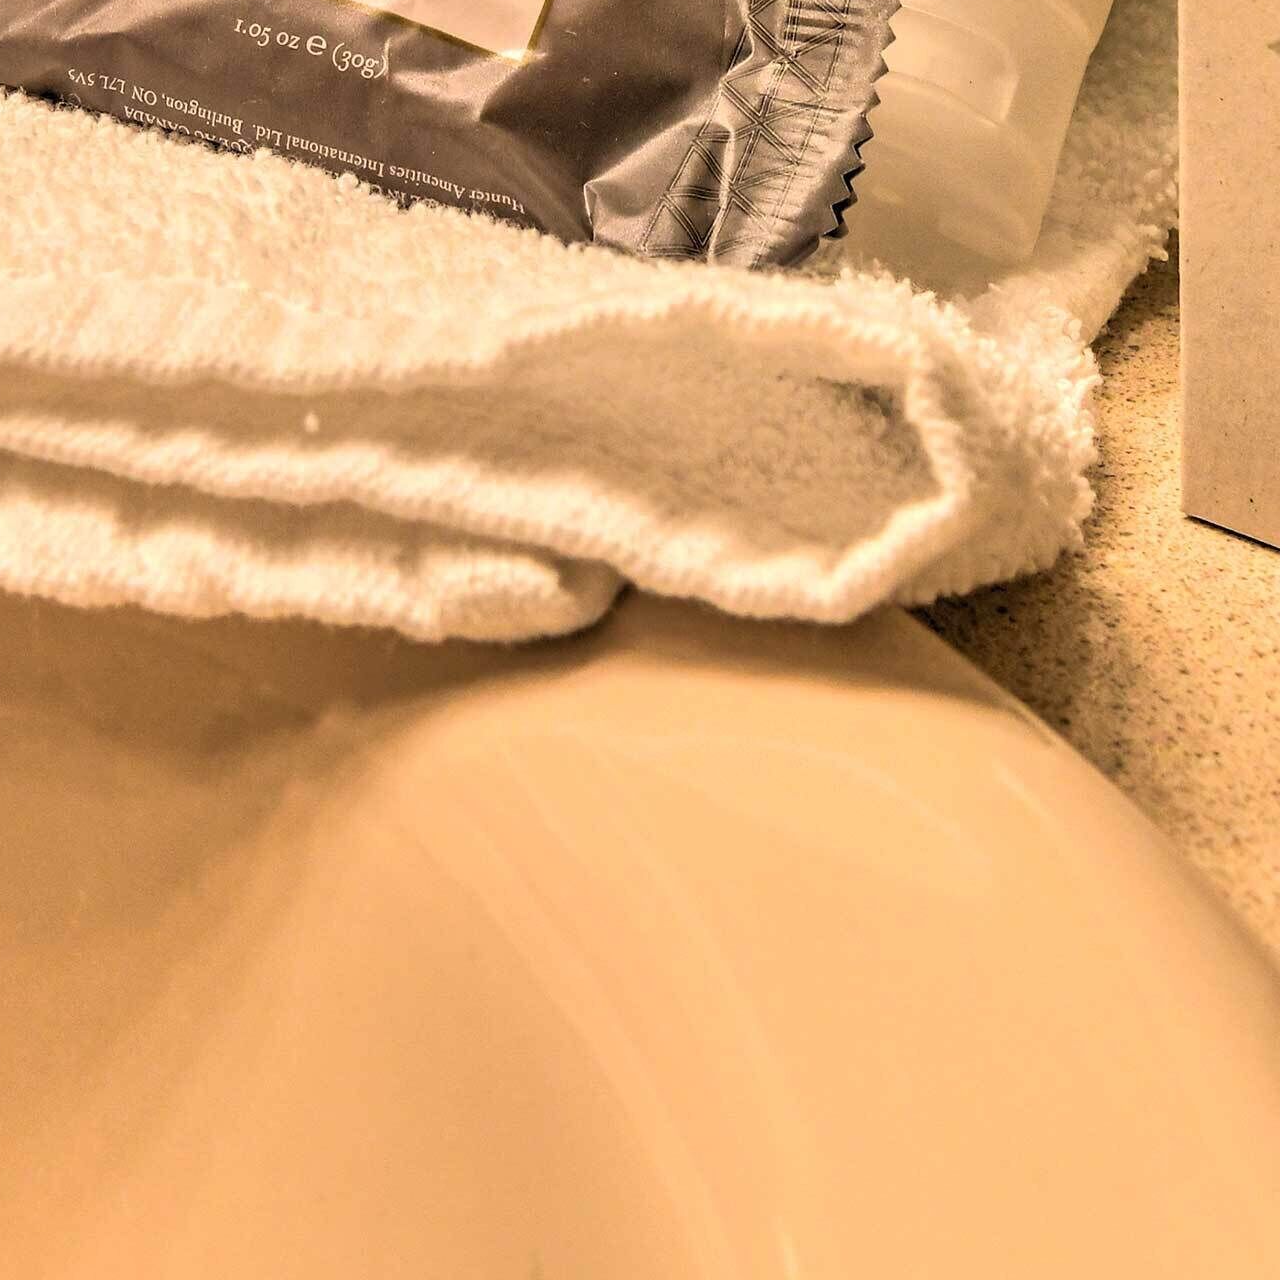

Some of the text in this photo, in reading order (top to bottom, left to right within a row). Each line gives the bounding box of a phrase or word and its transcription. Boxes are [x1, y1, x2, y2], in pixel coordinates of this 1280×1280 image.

[233, 18, 272, 47] 1.05
[276, 30, 301, 50] oz
[331, 42, 389, 80] (30g)
[99, 75, 126, 95] L7L
[131, 85, 158, 107] ON
[161, 93, 244, 135] Burlington,
[252, 124, 283, 147] Ltd.
[286, 135, 386, 179] International
[389, 165, 466, 200] Amenities
[468, 190, 526, 215] Hunter
